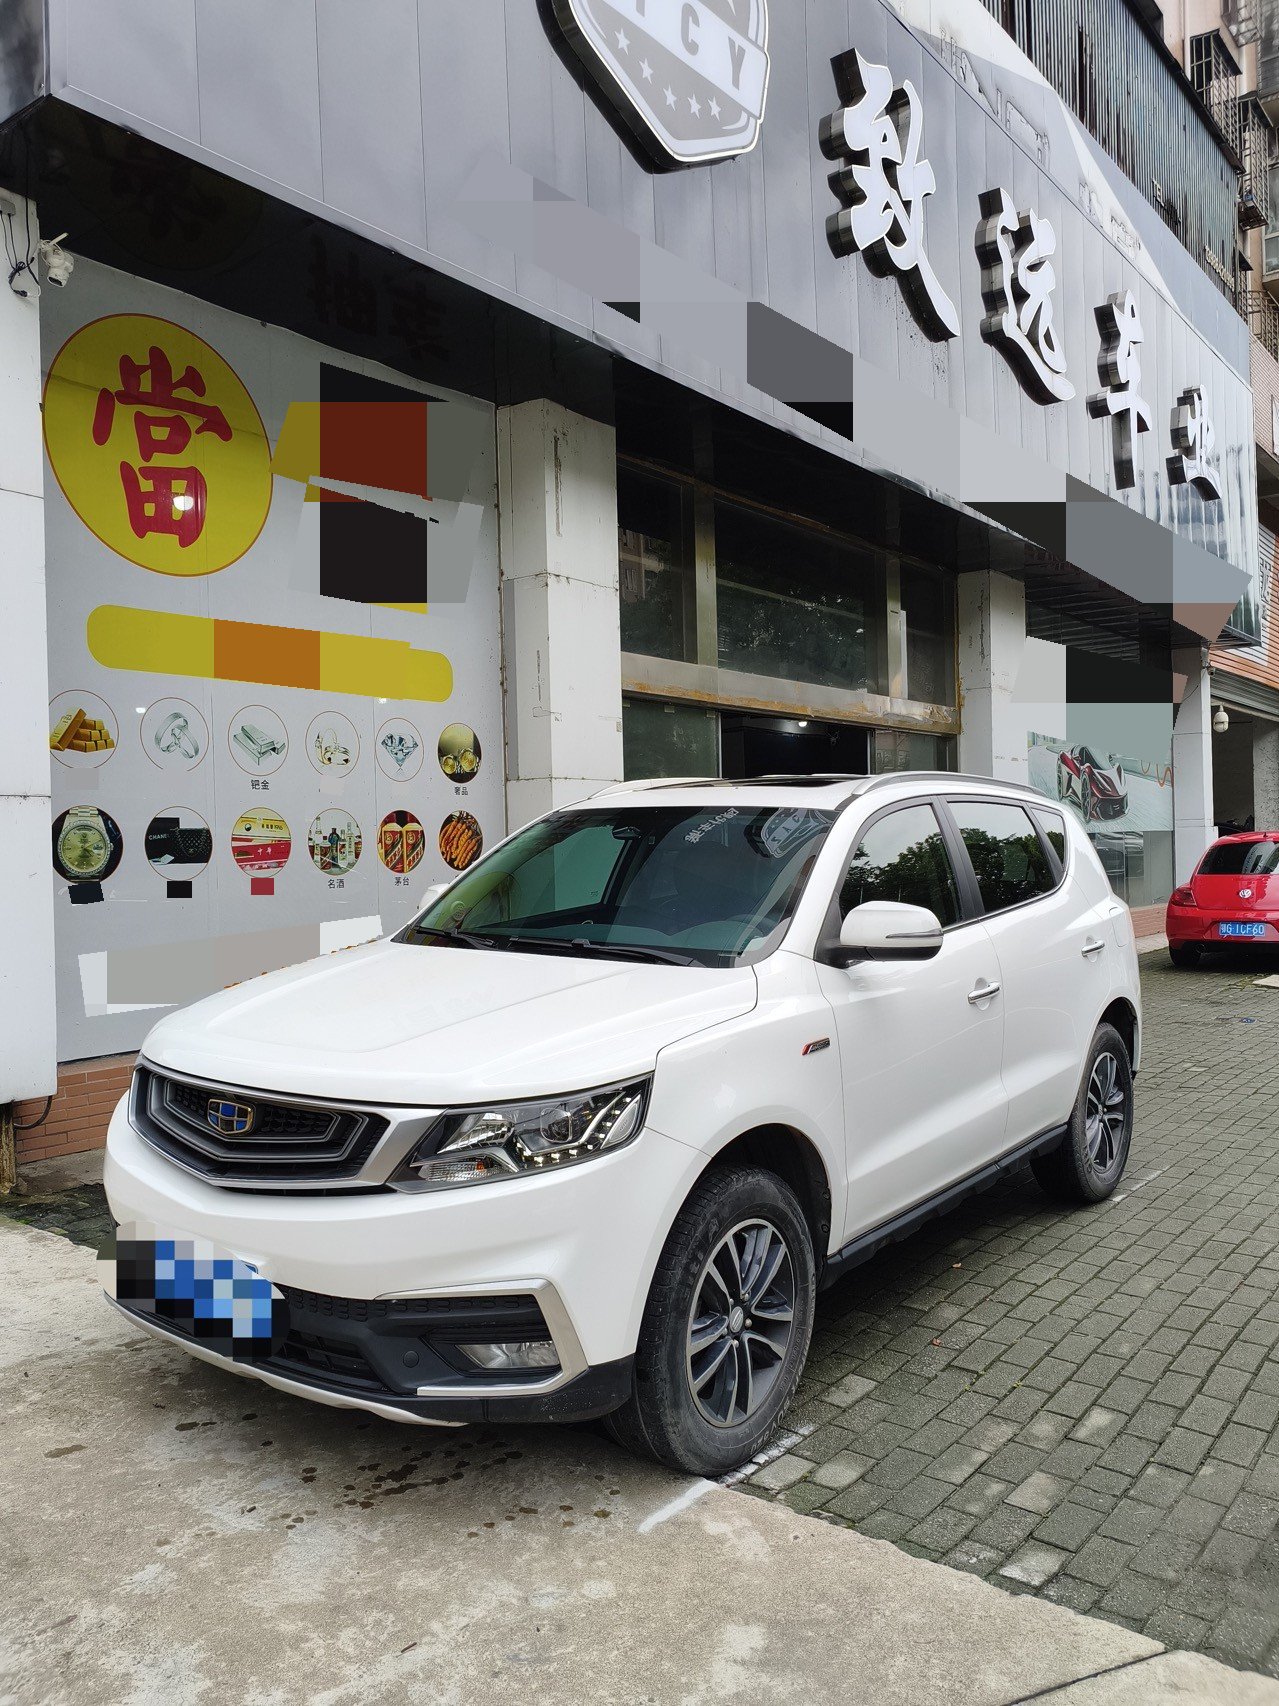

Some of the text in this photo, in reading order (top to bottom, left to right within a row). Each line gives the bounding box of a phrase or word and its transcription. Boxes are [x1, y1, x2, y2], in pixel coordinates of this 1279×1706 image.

[92, 345, 233, 549] 當
[327, 878, 345, 889] 名酒
[394, 876, 410, 887] 茅台
